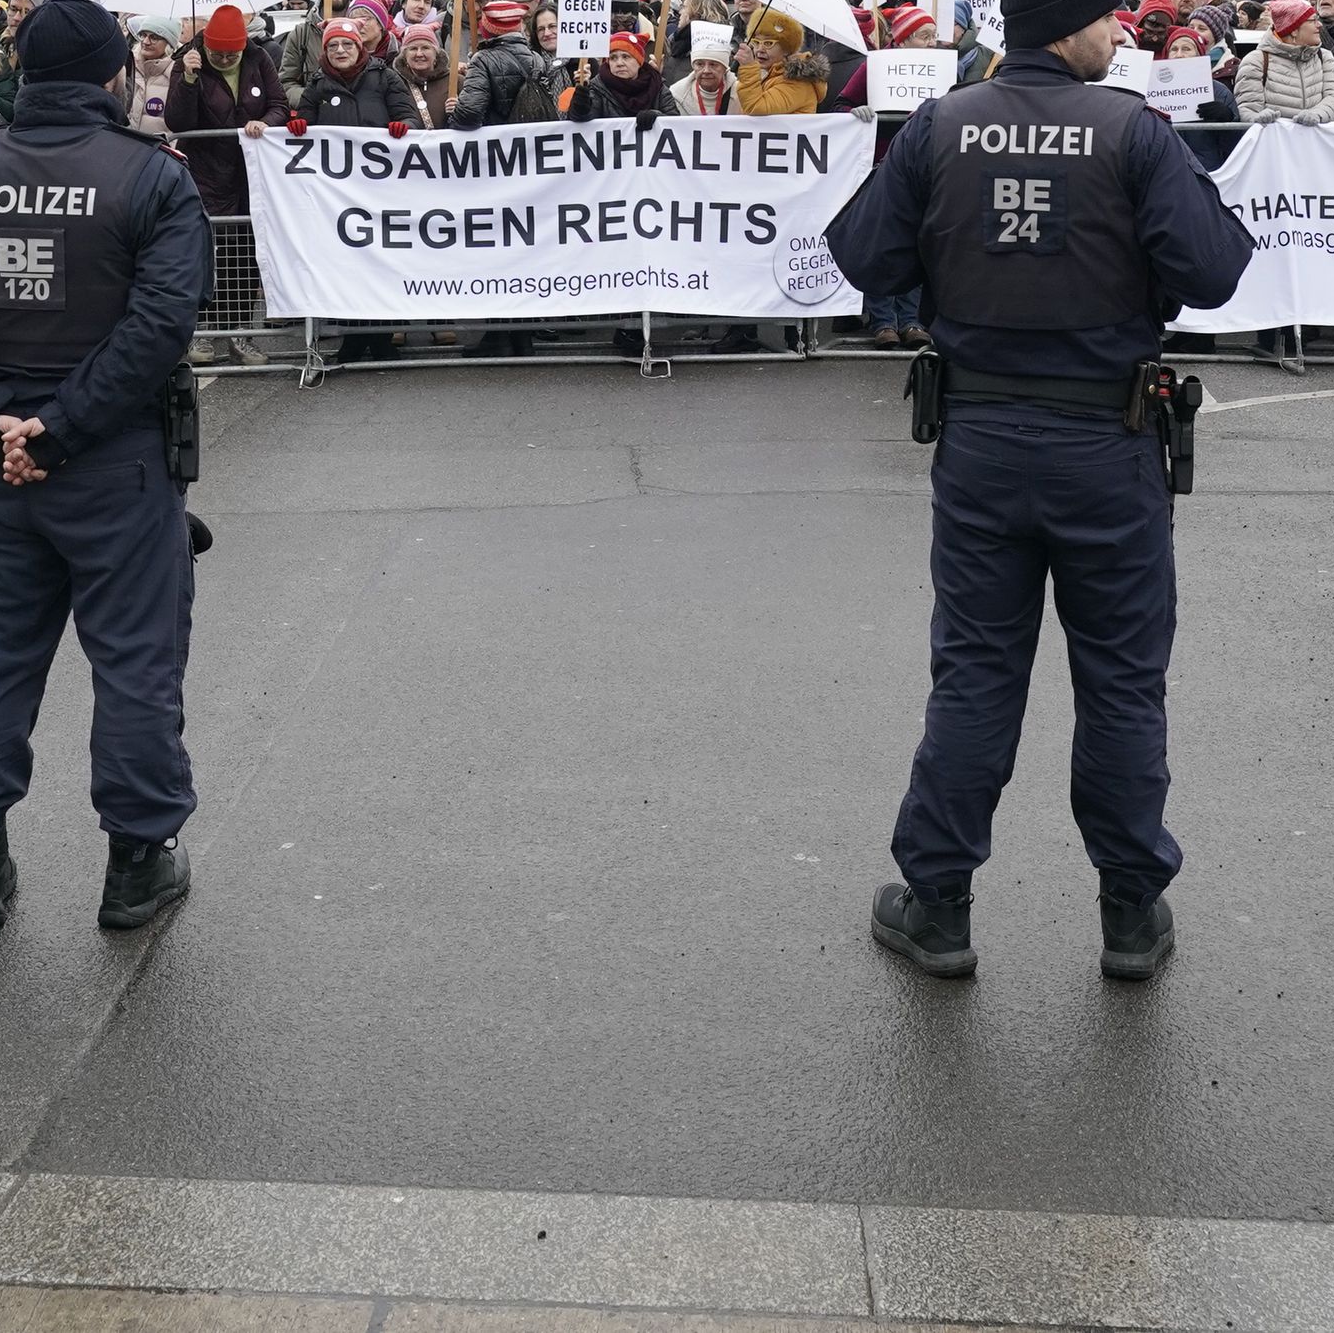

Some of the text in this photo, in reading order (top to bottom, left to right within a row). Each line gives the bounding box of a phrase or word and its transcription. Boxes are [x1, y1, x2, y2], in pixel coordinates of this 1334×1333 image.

[560, 22, 607, 34] RECHTS
[887, 64, 937, 77] HETZE
[887, 84, 937, 98] TÖTET
[1146, 86, 1209, 98] SCHENRECHTE
[1157, 104, 1188, 112] hützen
[959, 124, 1094, 156] POLIZEI
[285, 128, 829, 179] ZUSAMMENHALTEN
[993, 178, 1051, 212] BE
[337, 198, 777, 250] GEGEN RECHTS
[997, 212, 1041, 244] 24
[789, 236, 827, 252] OMA
[4, 278, 51, 301] 120
[403, 265, 709, 298] www.omasgegenrechts.at
[787, 270, 839, 291] RECHTS
